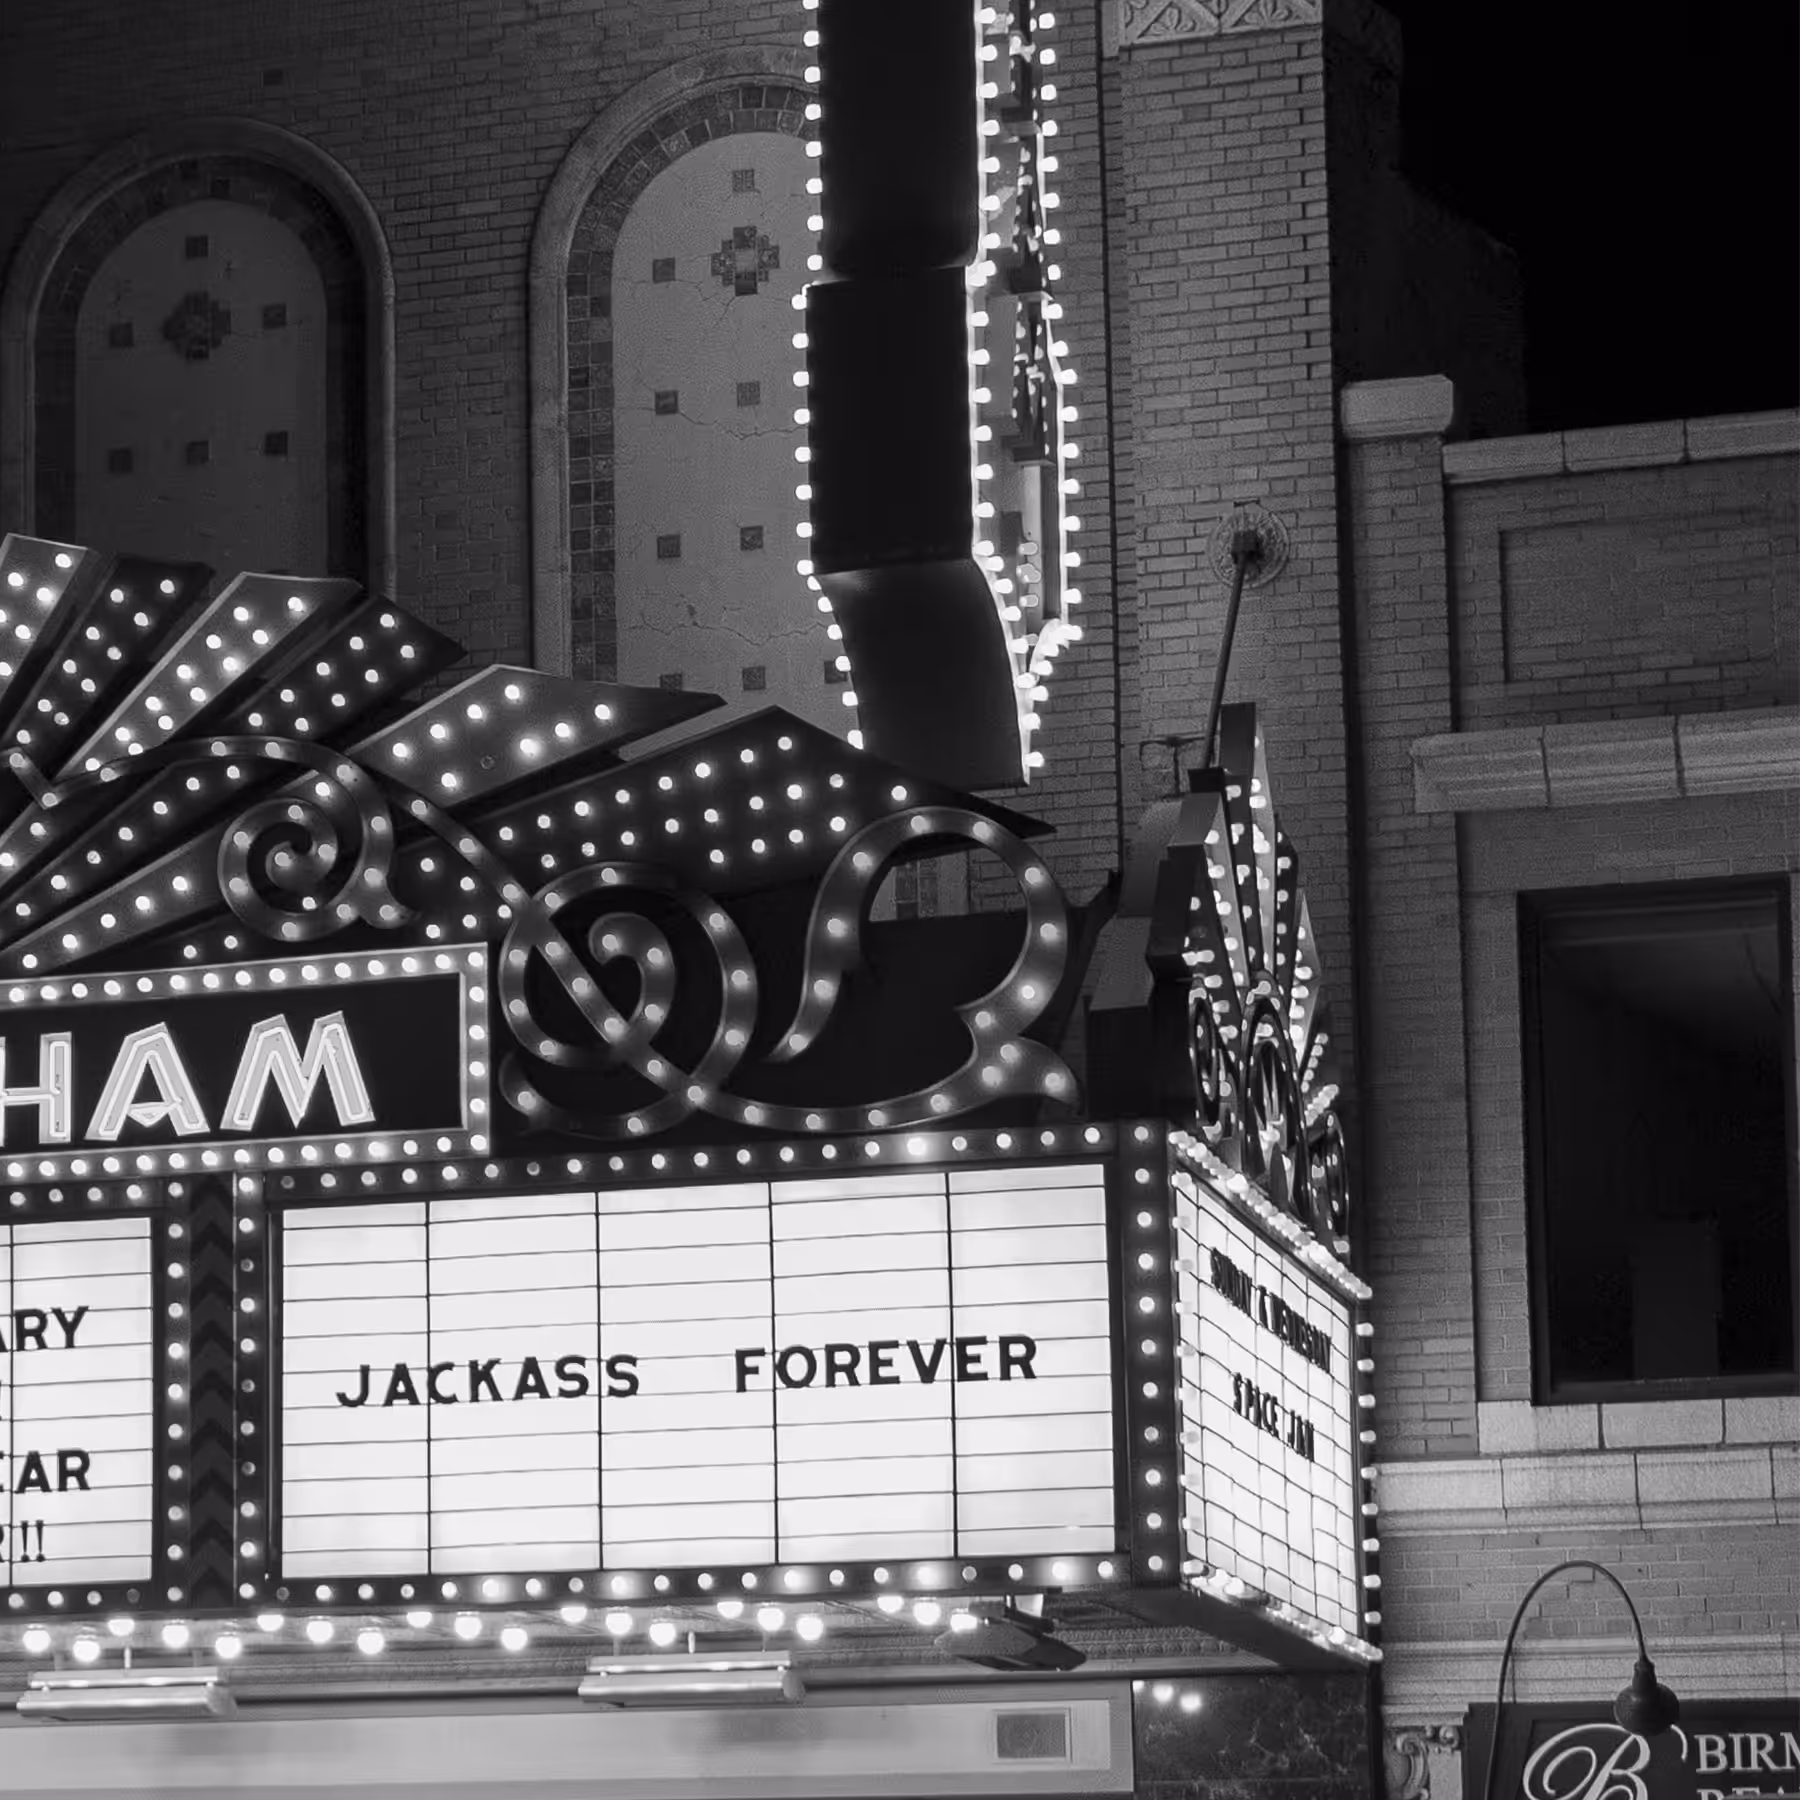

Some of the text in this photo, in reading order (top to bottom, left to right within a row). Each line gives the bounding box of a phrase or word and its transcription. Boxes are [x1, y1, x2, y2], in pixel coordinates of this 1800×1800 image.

[337, 1335, 1037, 1409] JACKASS FOREVER
[1233, 1372, 1279, 1438] SPACE
